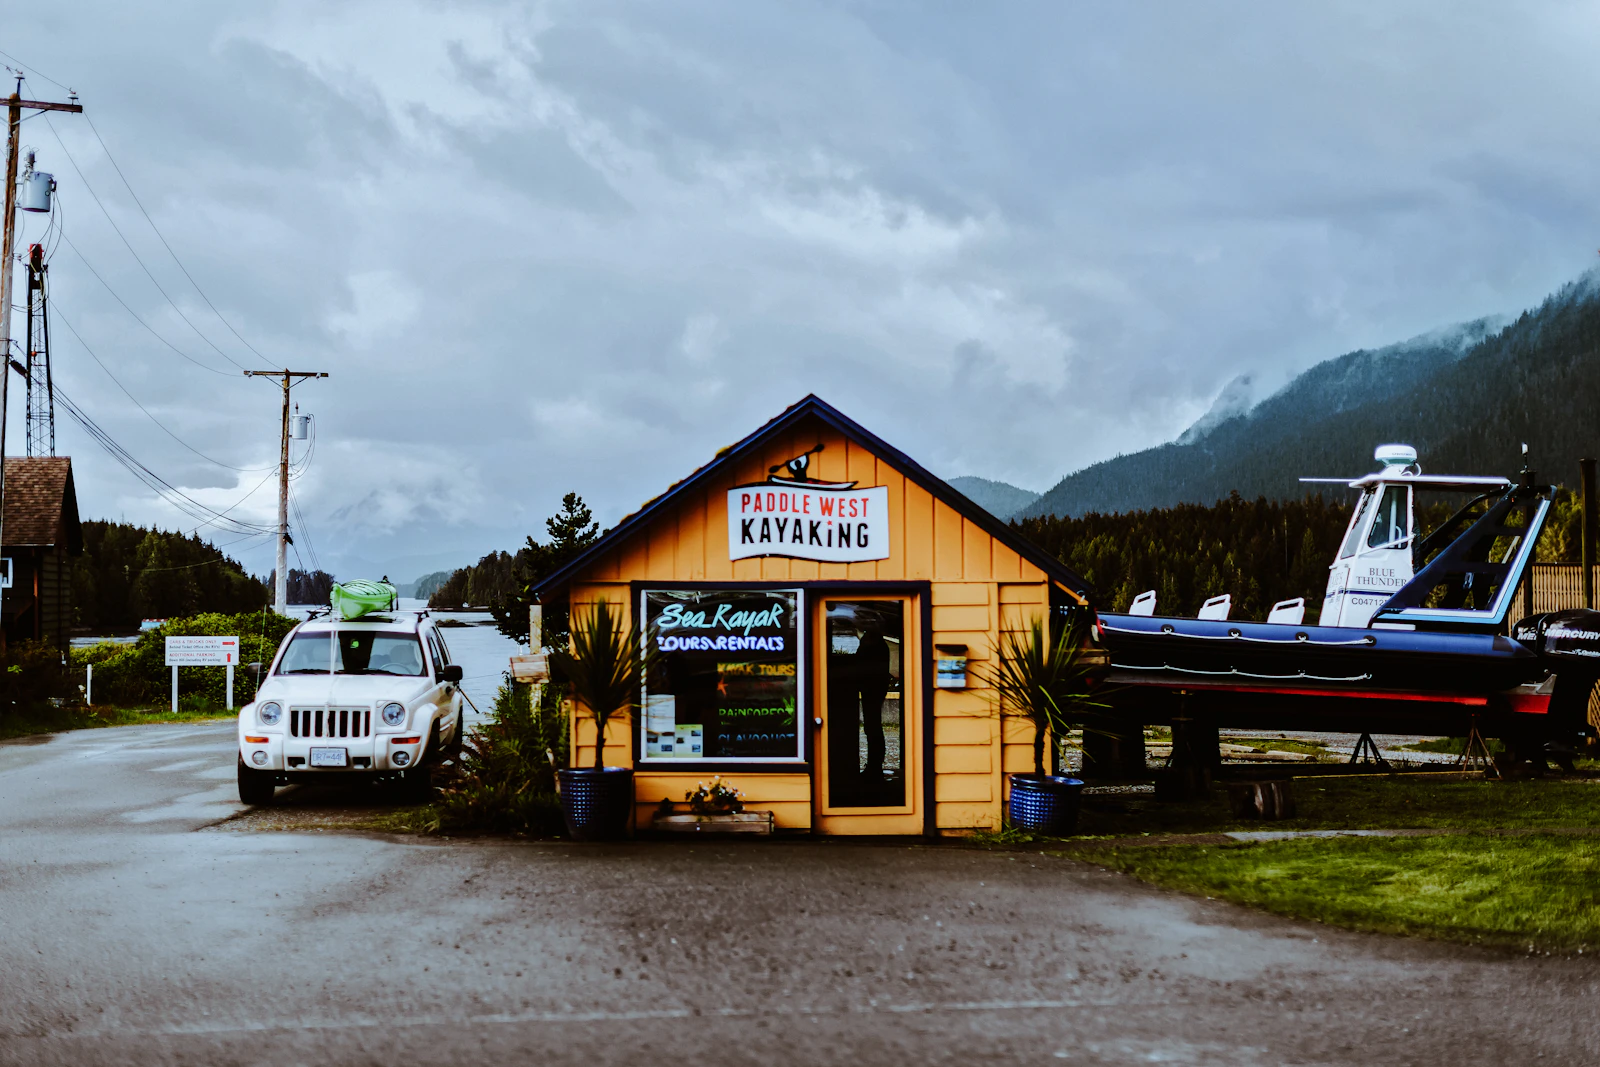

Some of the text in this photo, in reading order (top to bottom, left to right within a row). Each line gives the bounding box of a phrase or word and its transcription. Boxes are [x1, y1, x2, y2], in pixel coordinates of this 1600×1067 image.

[741, 492, 869, 518] PADDLE WEST
[1369, 567, 1395, 577] BLUE
[1356, 576, 1407, 587] THUNDER
[657, 603, 709, 628] Sea
[1544, 628, 1600, 640] MERCURY
[758, 664, 796, 676] TOURS
